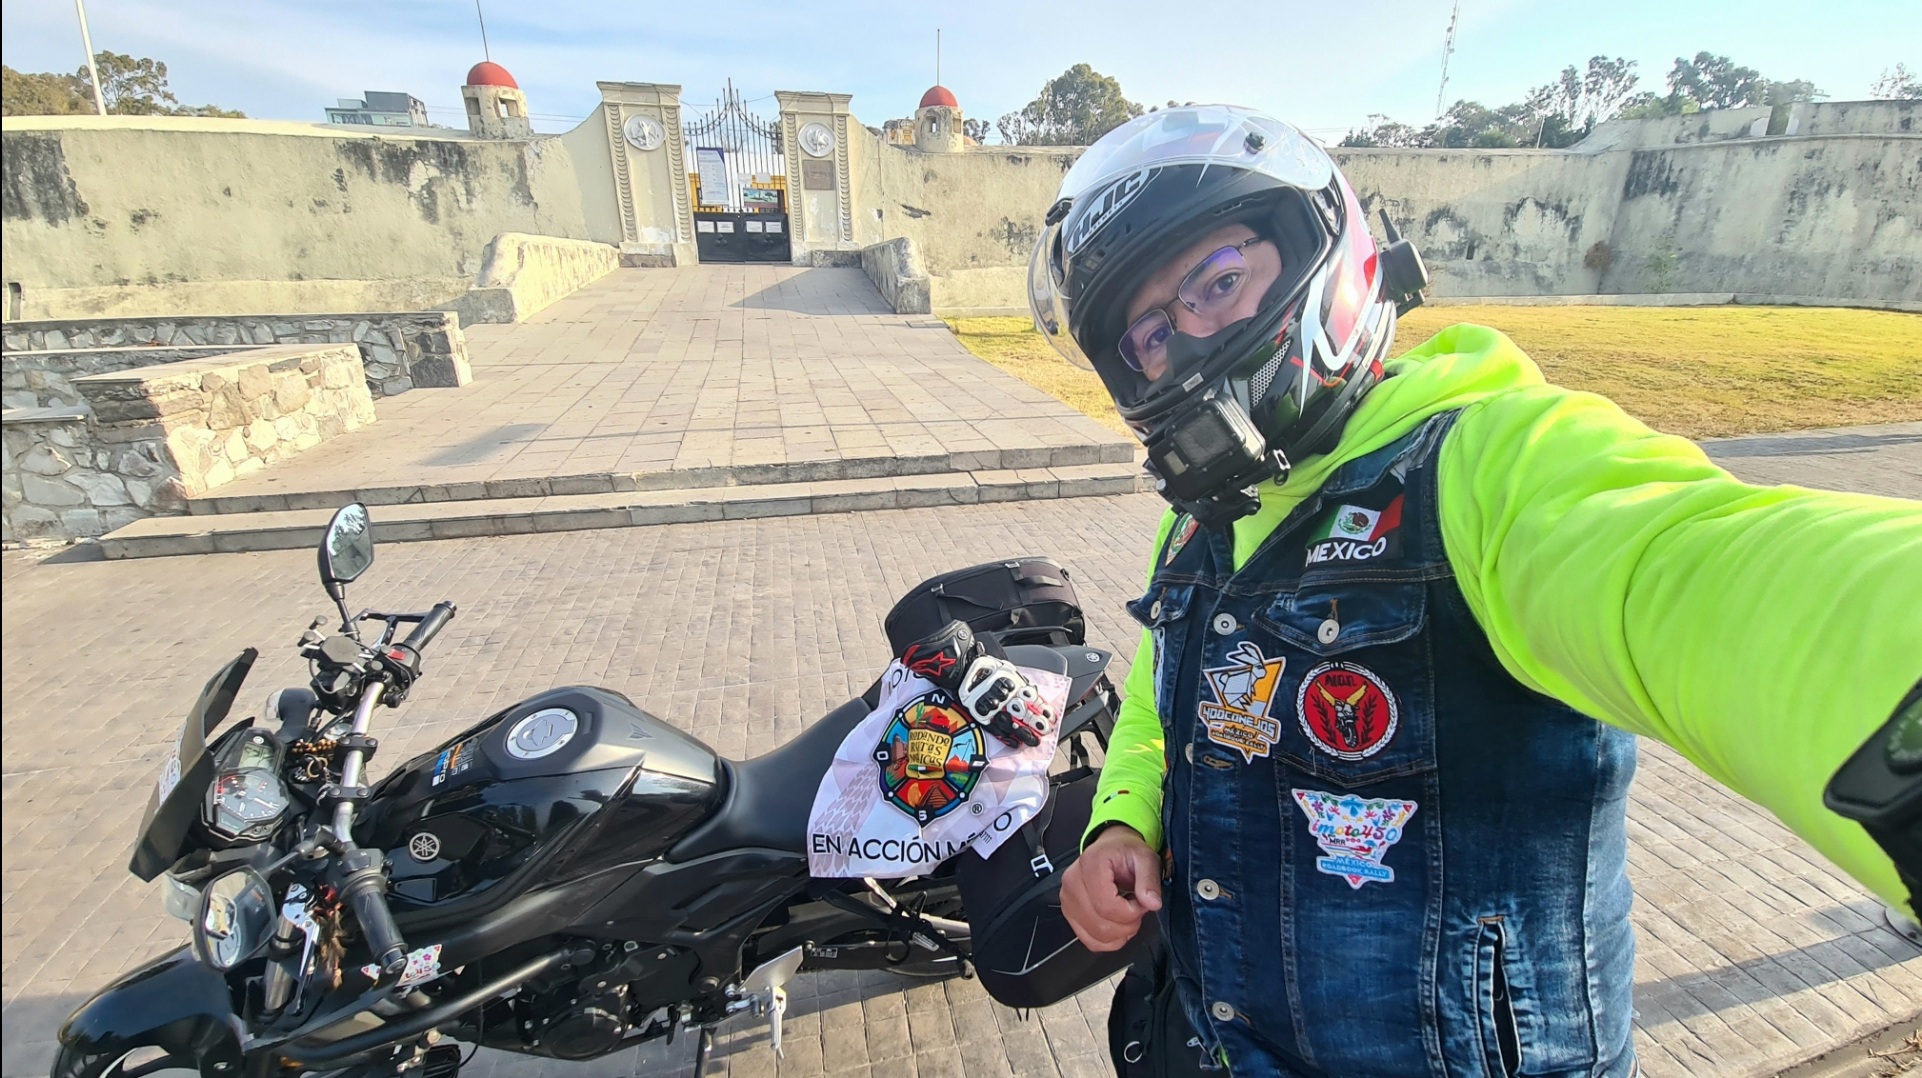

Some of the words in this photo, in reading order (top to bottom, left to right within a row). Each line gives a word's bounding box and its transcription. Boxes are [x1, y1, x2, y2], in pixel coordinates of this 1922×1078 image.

[1072, 170, 1142, 251] HJC
[1305, 536, 1387, 568] MEXICO
[812, 833, 841, 854] EN
[848, 835, 941, 864] ACCIÓN
